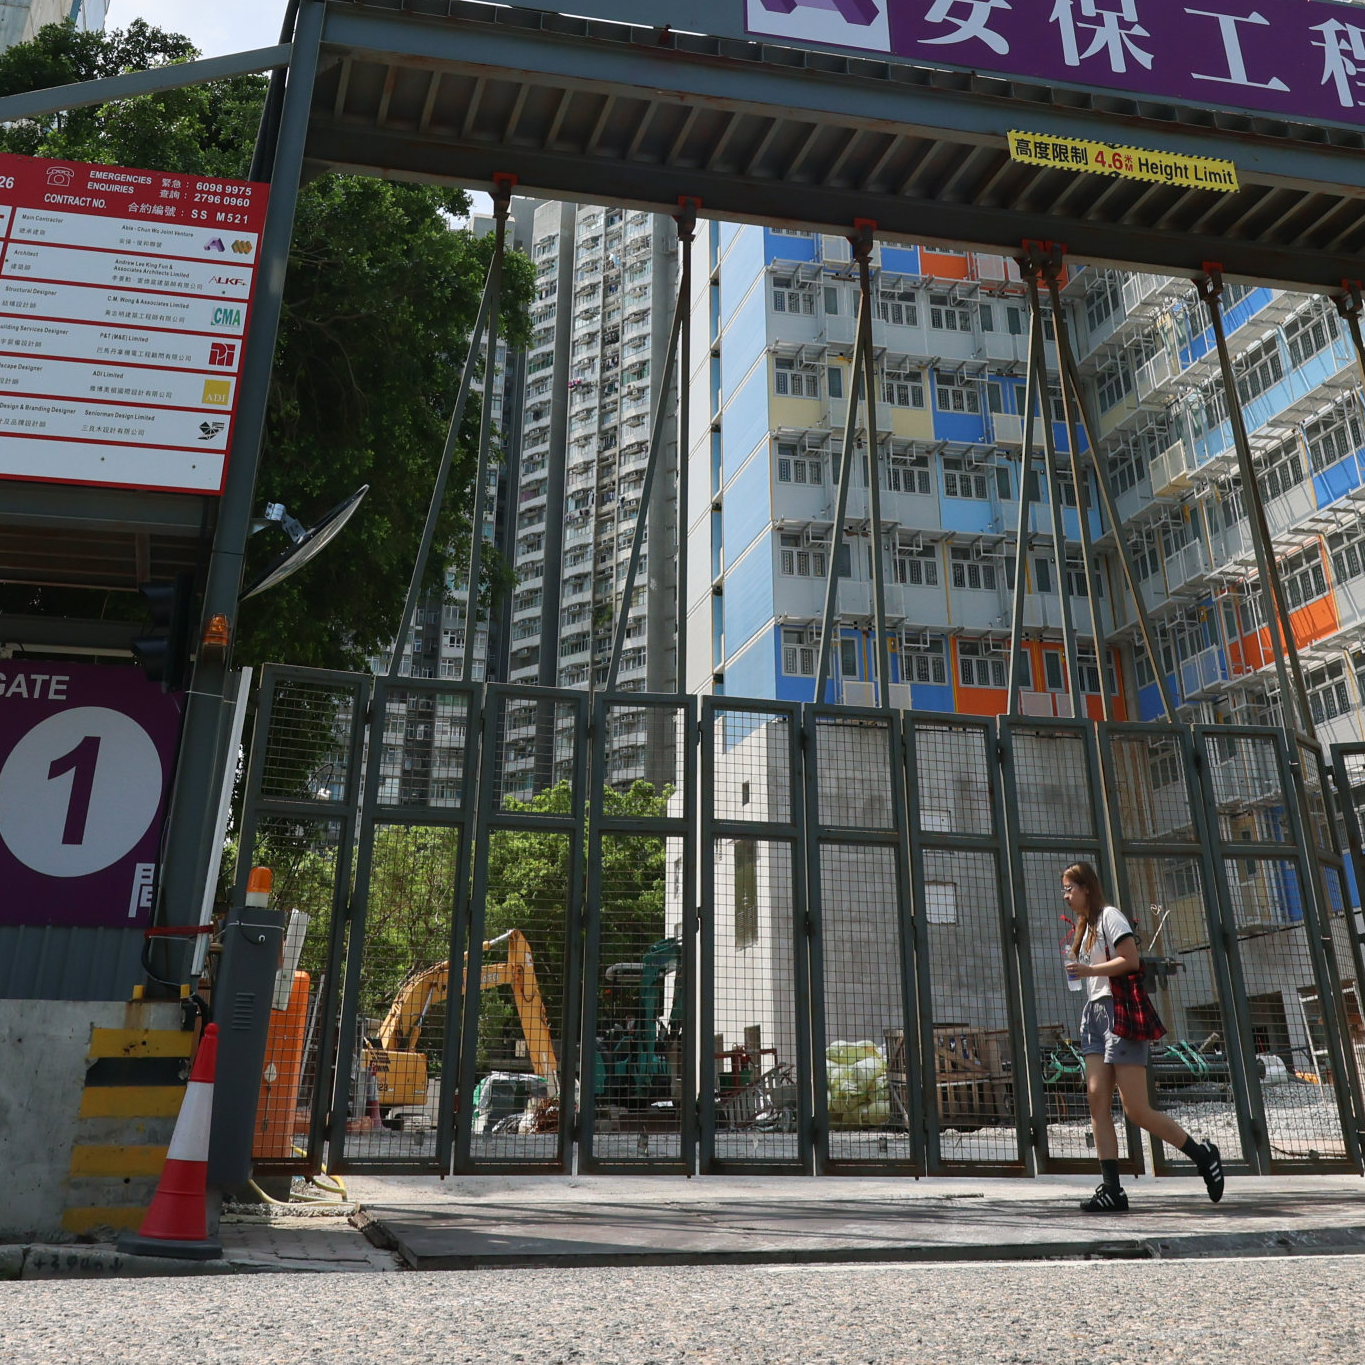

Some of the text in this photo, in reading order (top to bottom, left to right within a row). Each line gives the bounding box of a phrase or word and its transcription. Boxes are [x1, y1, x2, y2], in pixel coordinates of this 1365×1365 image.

[1014, 137, 1235, 185] 高度限制 4.6 米 Height Limit
[89, 170, 152, 185] EMERGENCIES
[196, 182, 223, 193] 6098
[225, 184, 252, 196] 9975
[87, 181, 134, 194] ENQUIRIES
[193, 193, 221, 204] 2796
[223, 196, 250, 207] 0960
[44, 193, 92, 208] CONTRACT
[92, 198, 107, 209] NO.
[190, 209, 208, 220] SS
[216, 212, 249, 225] M521
[35, 216, 64, 224] Contractor
[137, 226, 151, 234] Chun
[160, 228, 174, 236] Joint
[14, 249, 39, 257] Architect
[115, 259, 135, 267] Andrew
[113, 265, 142, 274] Associates
[143, 268, 170, 277] Architects
[5, 286, 58, 296] Structural Designer
[120, 297, 135, 305] Wong
[140, 299, 169, 308] Associates
[213, 307, 241, 326] CMA
[20, 324, 44, 333] Services
[44, 327, 69, 335] Designer
[111, 333, 128, 342] (M&E)
[128, 335, 149, 343] Limited
[17, 364, 43, 372] Designer
[205, 394, 227, 403] ADI
[0, 402, 19, 411] Design
[24, 405, 51, 414] Branding
[51, 407, 76, 415] Designer
[85, 409, 155, 422] Seniorman Design Limited
[46, 734, 102, 846] 1
